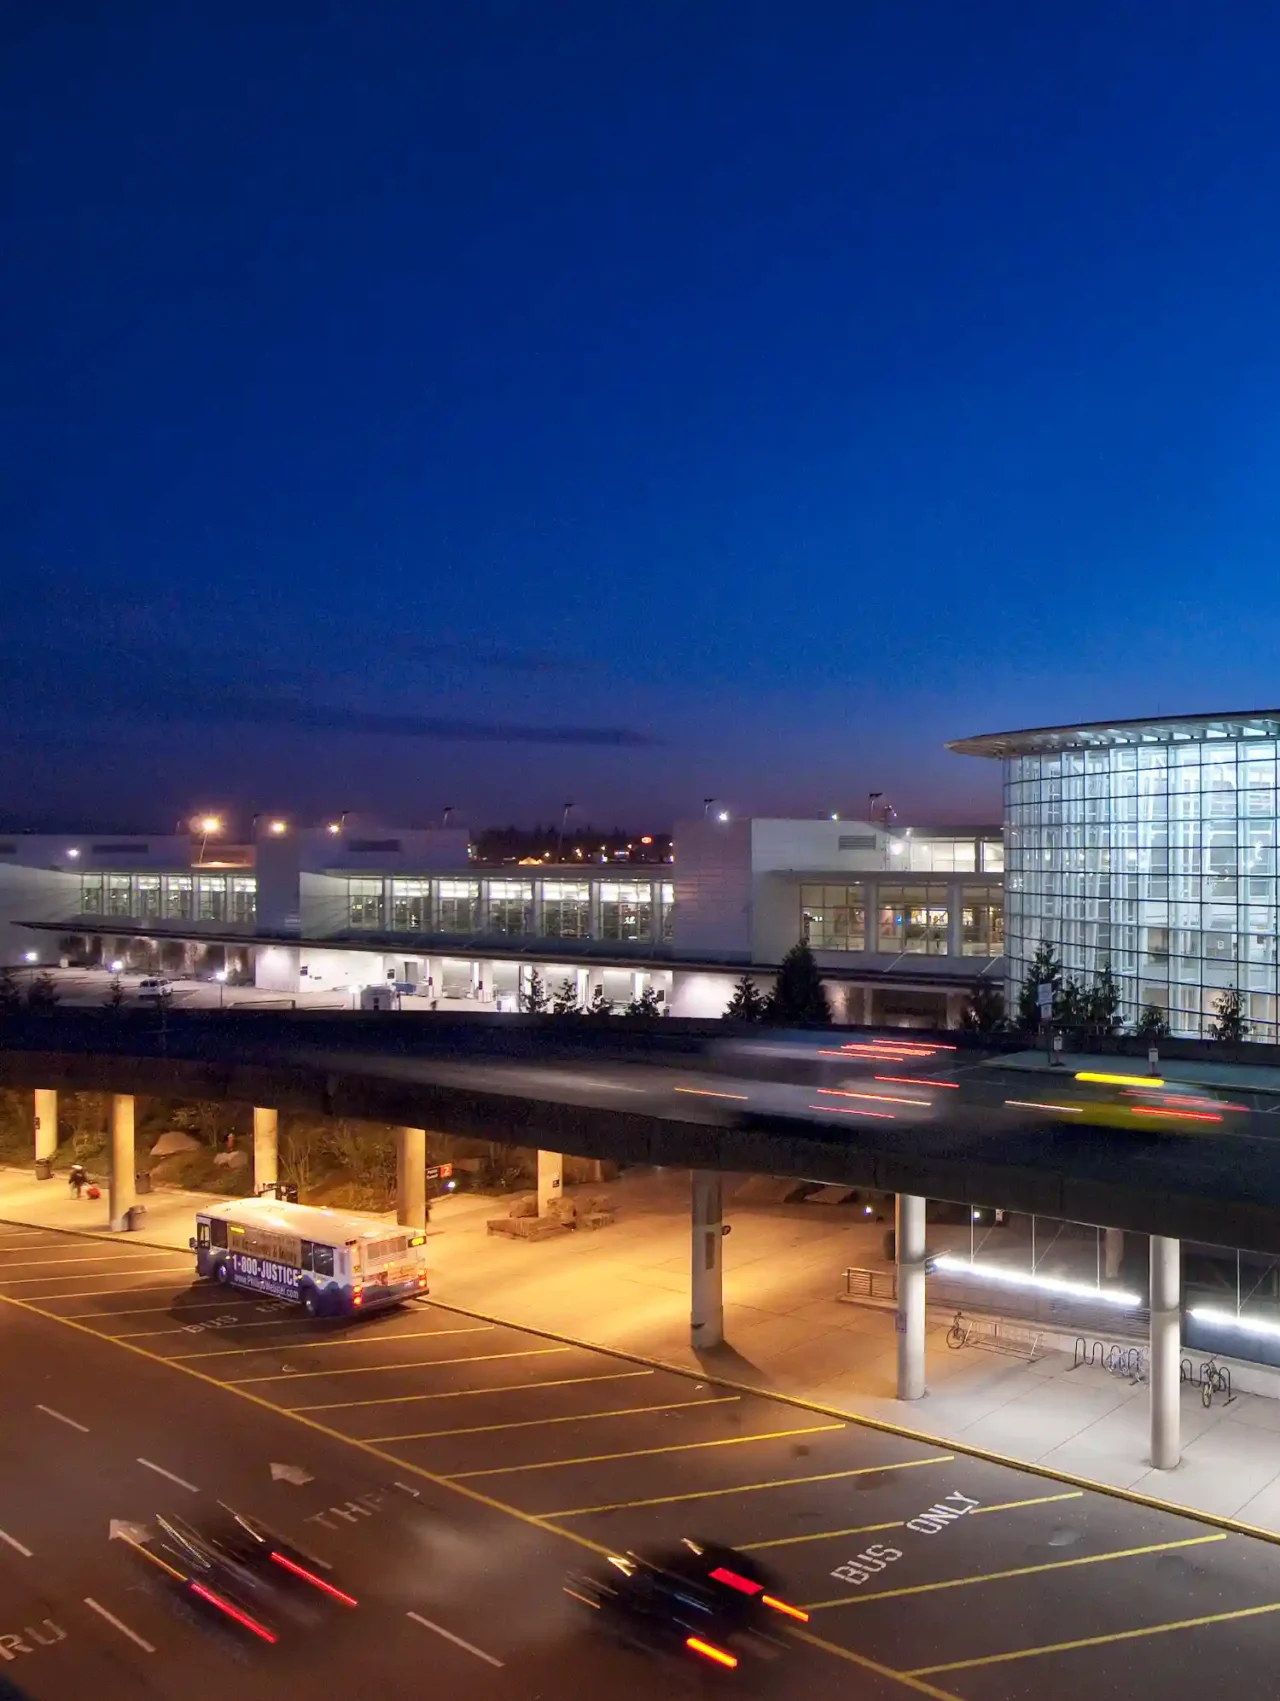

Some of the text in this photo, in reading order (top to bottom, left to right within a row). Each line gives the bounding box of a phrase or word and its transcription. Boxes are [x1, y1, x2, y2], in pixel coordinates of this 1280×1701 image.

[232, 1254, 299, 1287] 1-800-JUSTICE
[181, 1315, 239, 1334] BUS
[829, 1490, 981, 1586] BUS ONLY
